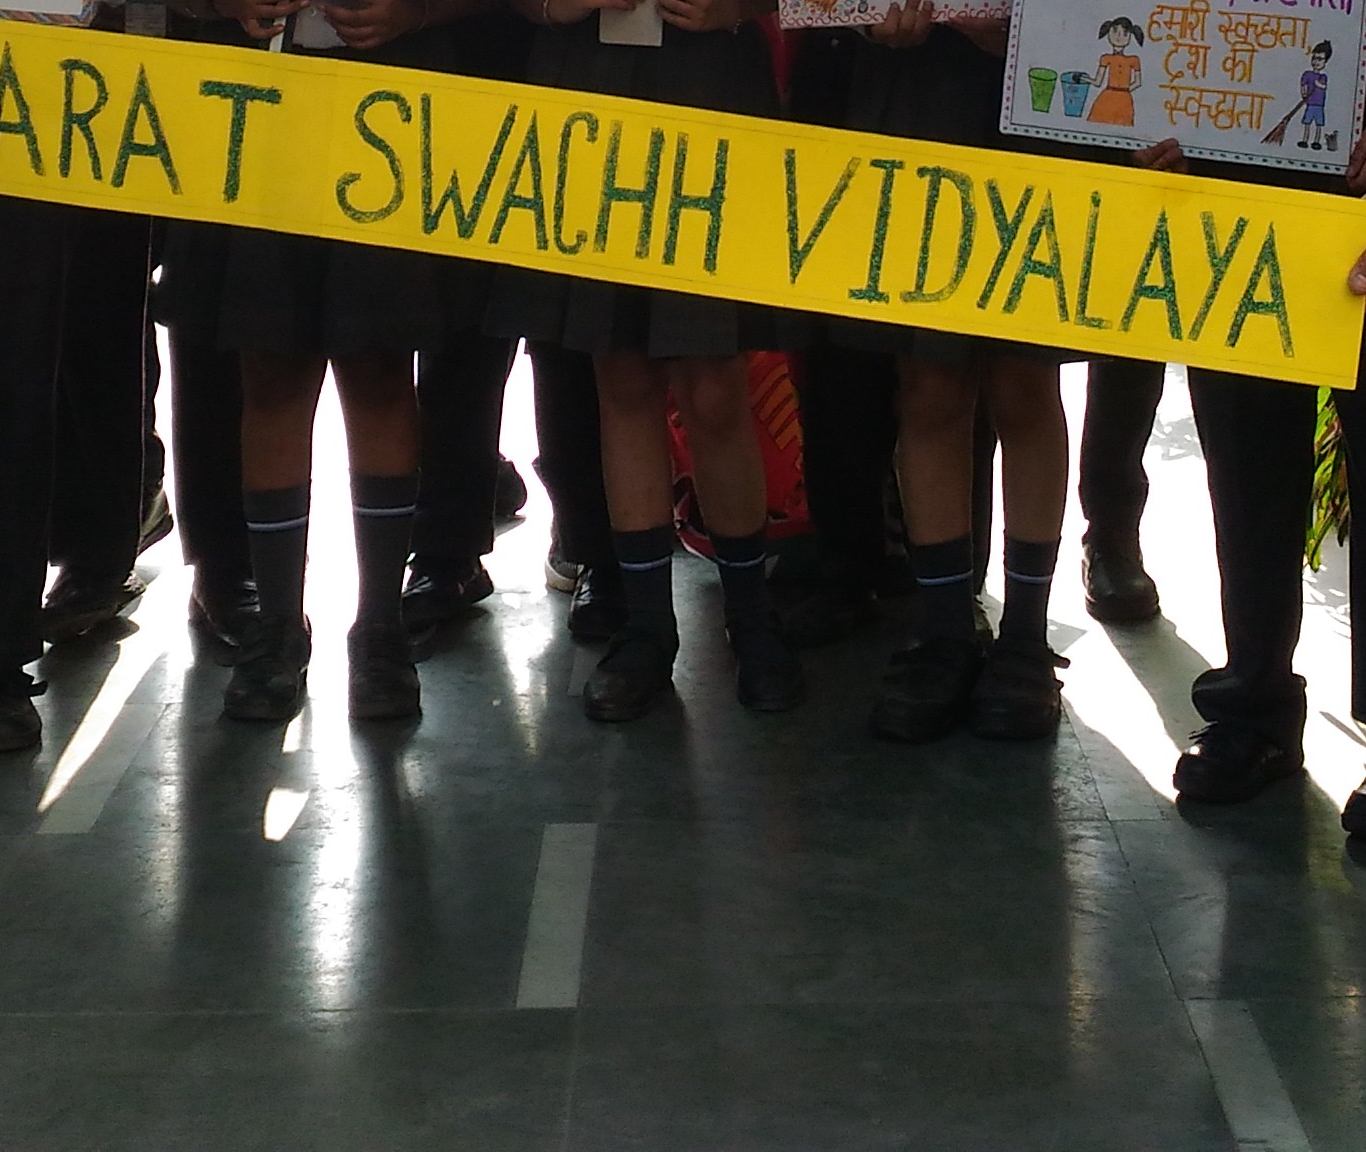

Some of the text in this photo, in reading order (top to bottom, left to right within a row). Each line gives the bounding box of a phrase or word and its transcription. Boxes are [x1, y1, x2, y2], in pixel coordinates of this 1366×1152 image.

[1164, 34, 1259, 83] देश की
[1158, 84, 1275, 130] स्वच्छता
[334, 89, 730, 277] SWACHH
[784, 147, 1295, 358] VIDYALAYA
